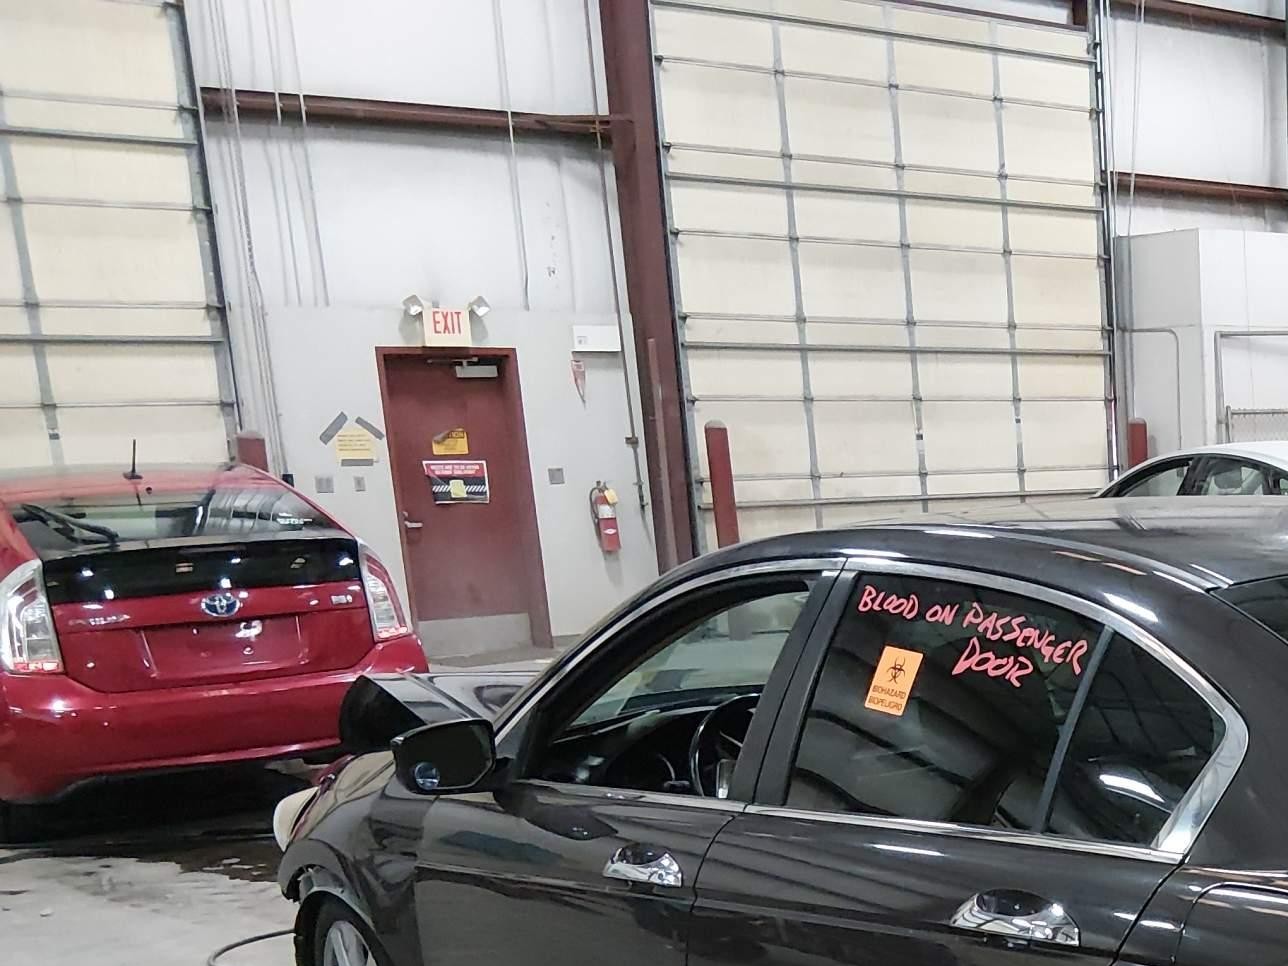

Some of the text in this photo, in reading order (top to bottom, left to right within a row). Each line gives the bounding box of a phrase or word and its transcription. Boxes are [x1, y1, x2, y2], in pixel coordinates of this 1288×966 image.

[432, 310, 462, 334] EXIT
[857, 584, 1088, 676] BLOOD ON PASSENGER
[951, 637, 1034, 688] DOOR
